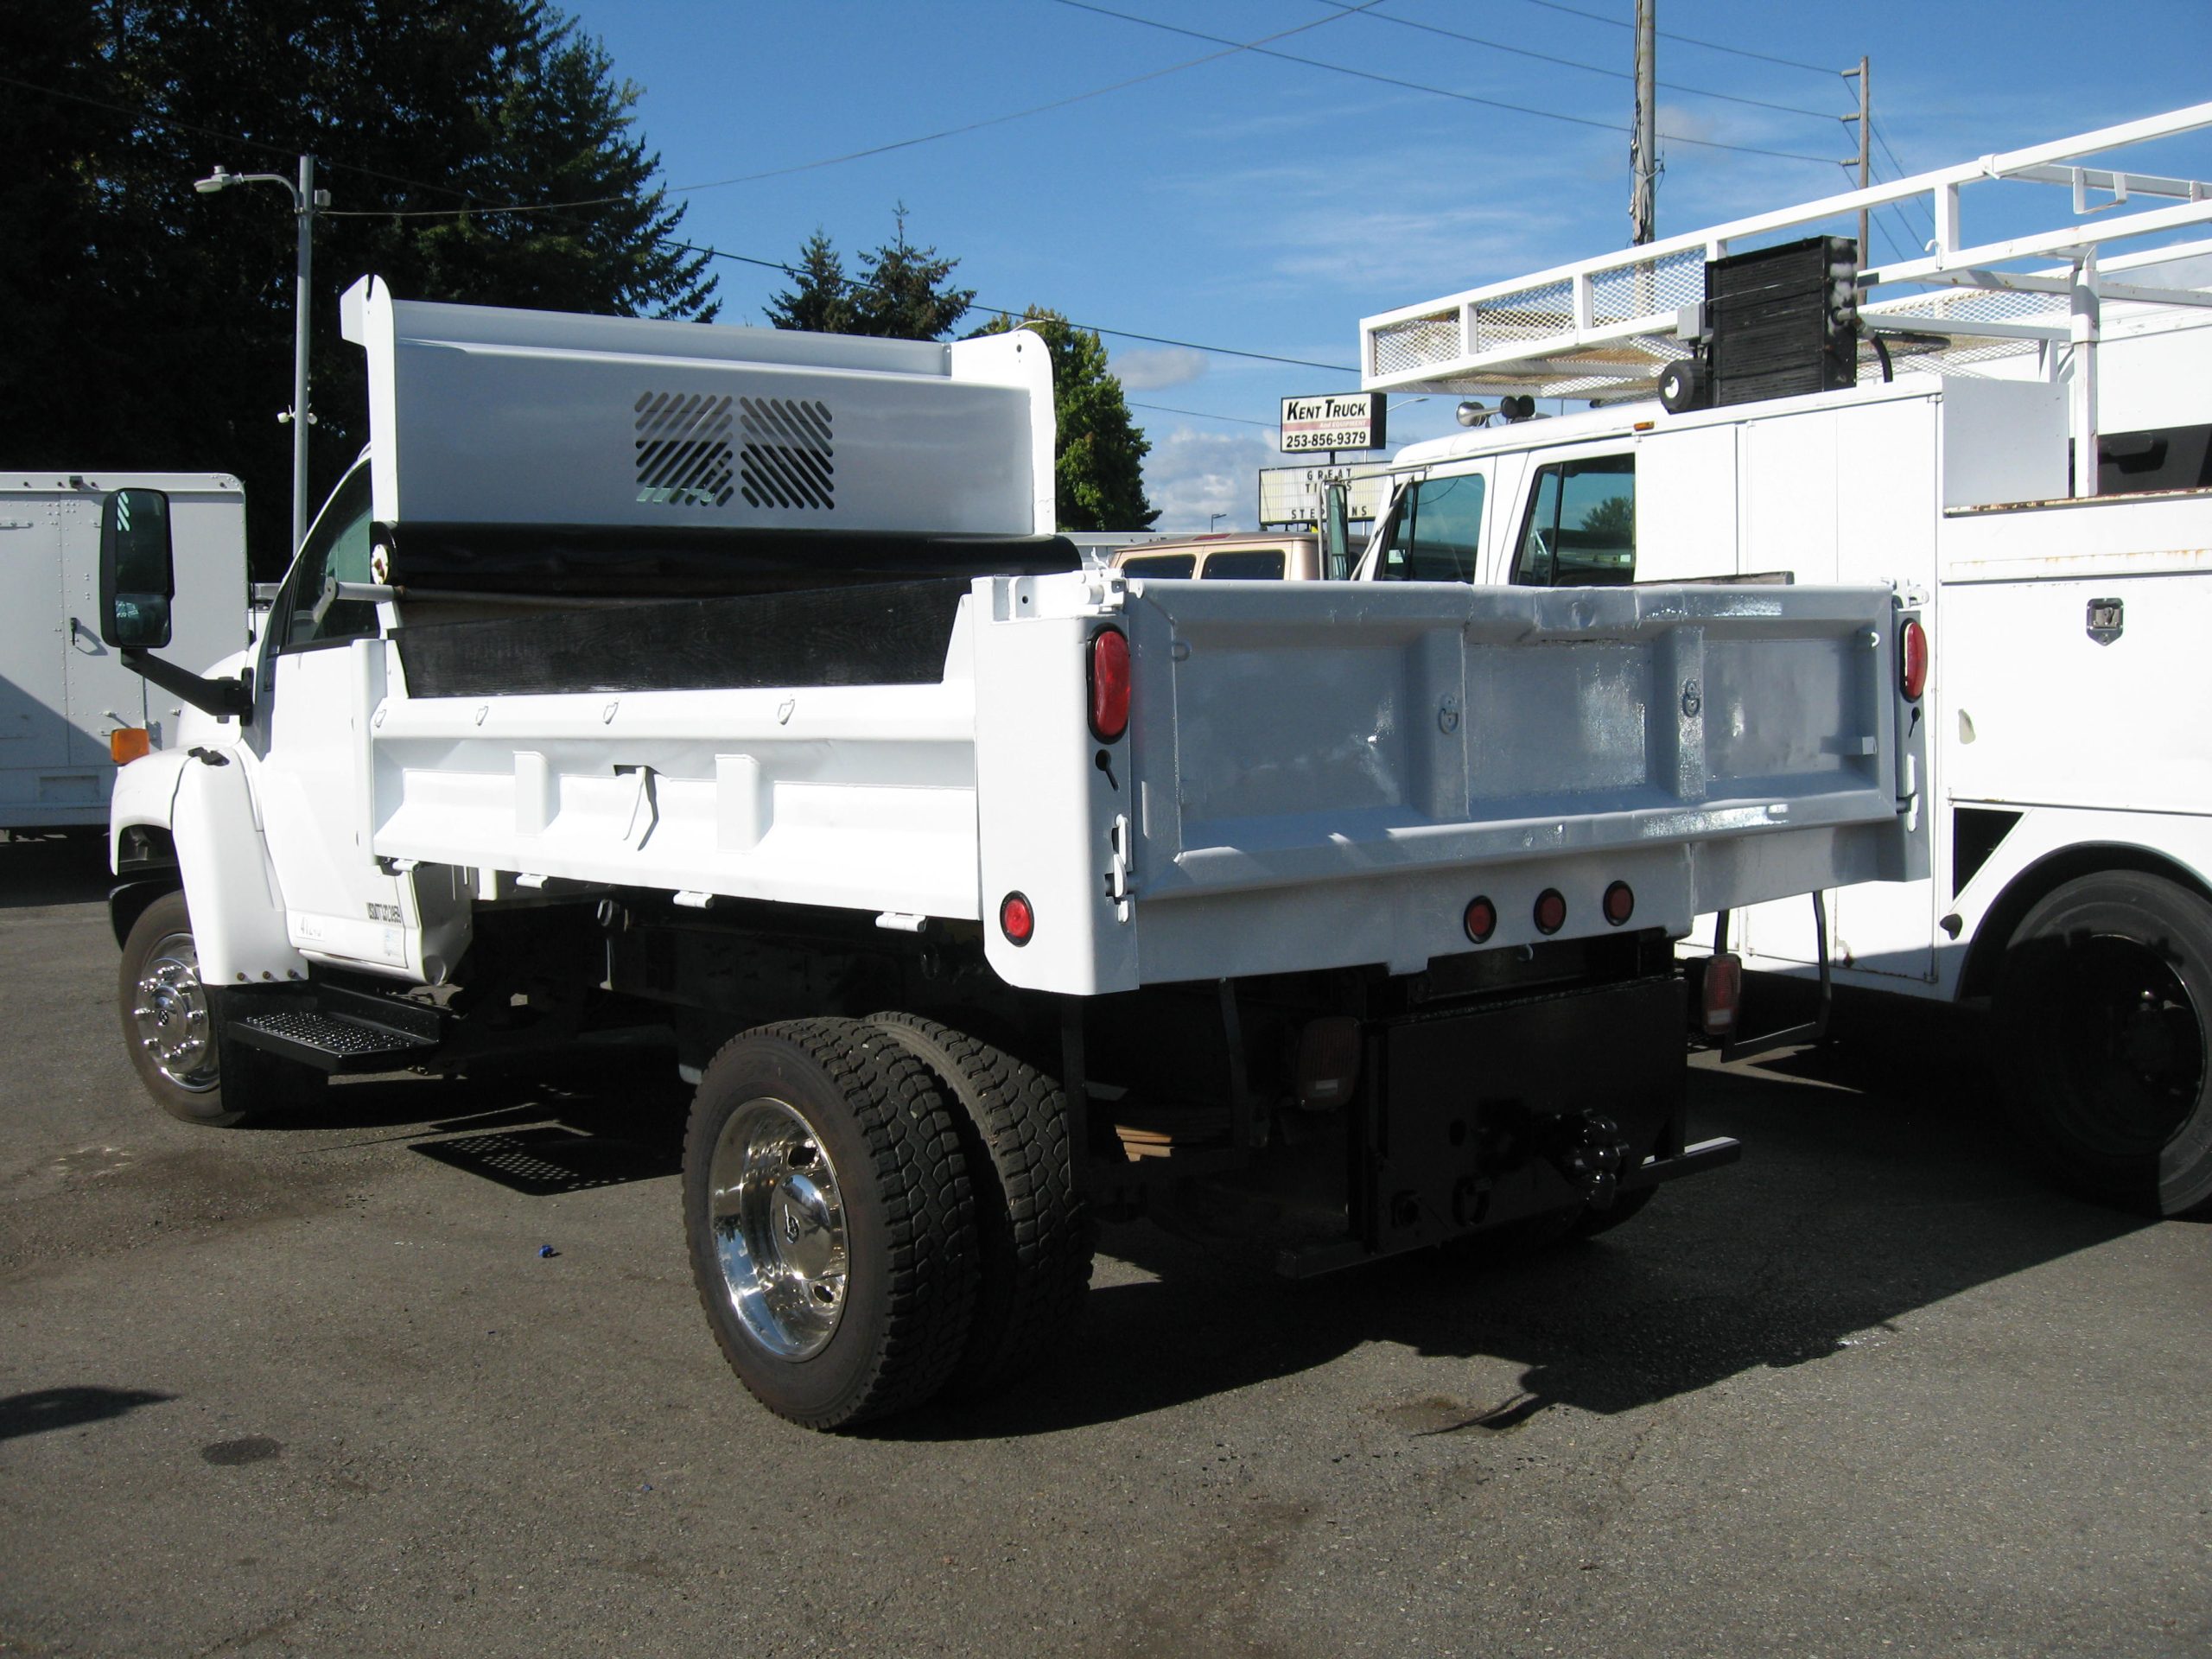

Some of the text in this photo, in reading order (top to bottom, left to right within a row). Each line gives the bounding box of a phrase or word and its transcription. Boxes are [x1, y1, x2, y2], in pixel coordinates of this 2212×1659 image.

[1287, 398, 1367, 421] KENT TRUCK
[1332, 419, 1367, 429] EQUIPMENT
[1286, 431, 1366, 448] 253-856-9379
[1306, 467, 1351, 480] GREAT
